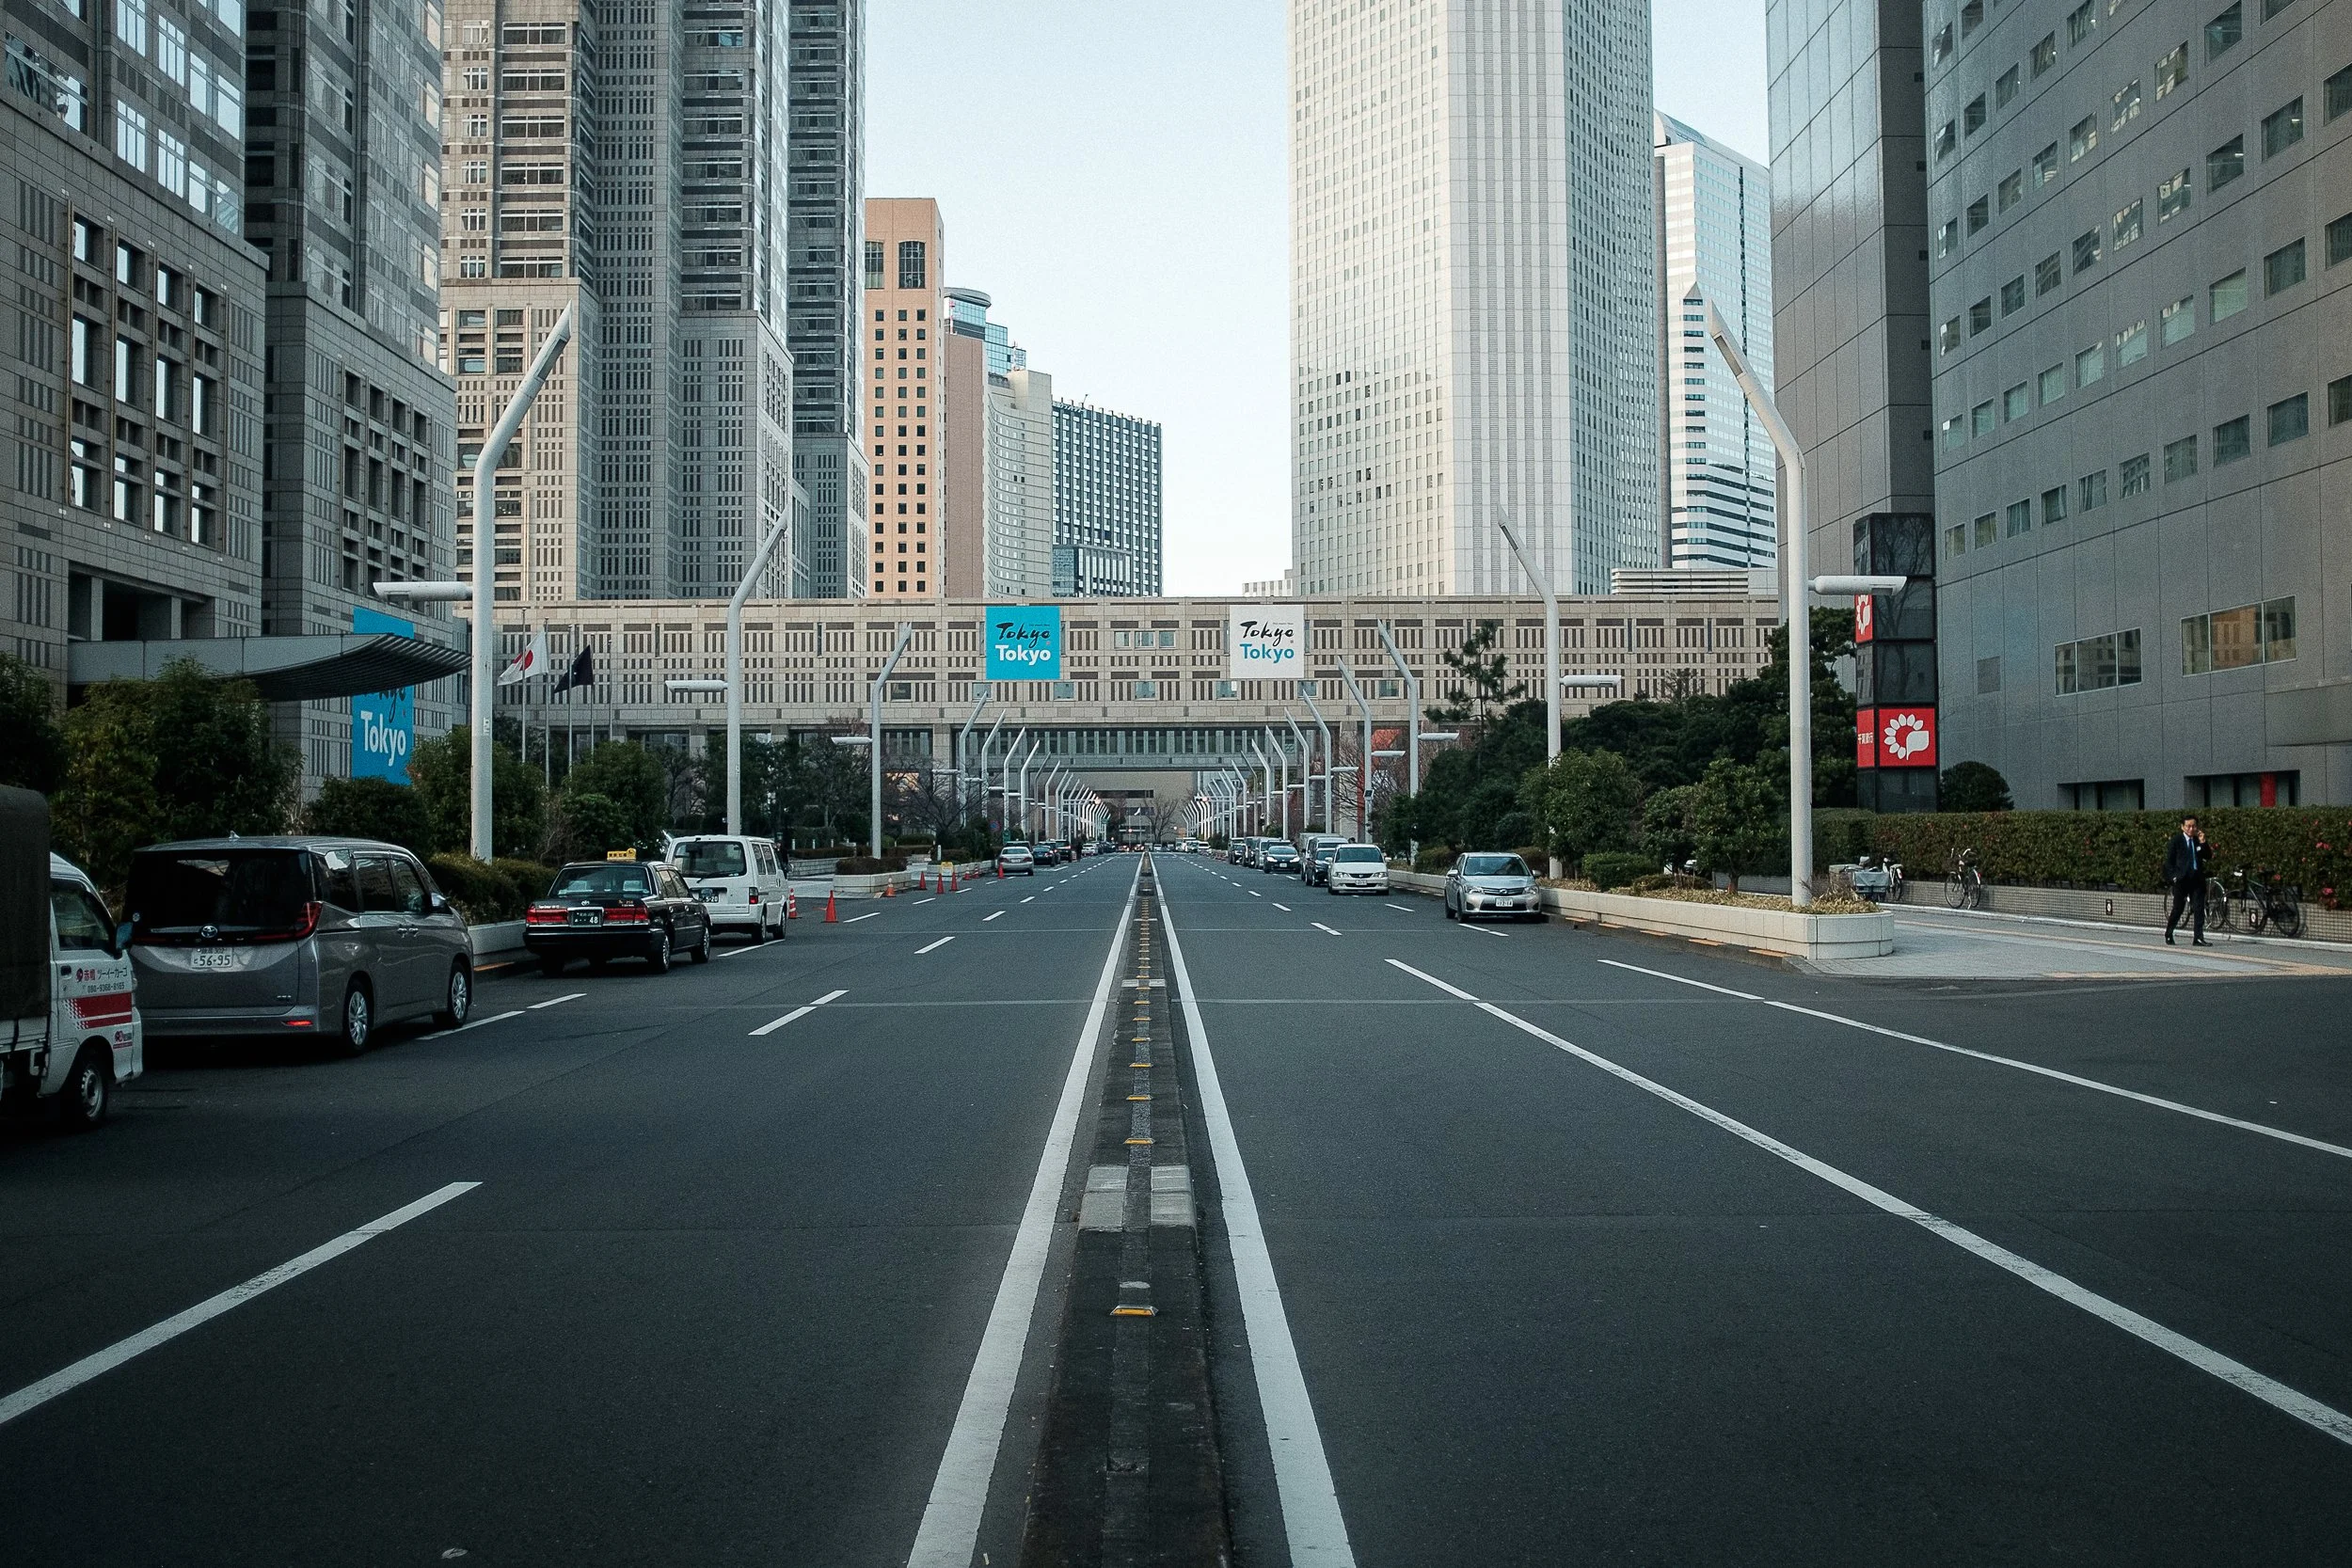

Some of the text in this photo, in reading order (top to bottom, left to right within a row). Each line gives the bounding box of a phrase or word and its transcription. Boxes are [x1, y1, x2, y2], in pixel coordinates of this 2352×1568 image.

[995, 622, 1051, 648] Tokyo
[1239, 621, 1295, 647] Tokyo
[994, 644, 1052, 666] Tokyo
[1239, 643, 1295, 664] Tokyo
[360, 710, 406, 767] Tokyo
[199, 954, 231, 967] 56-95
